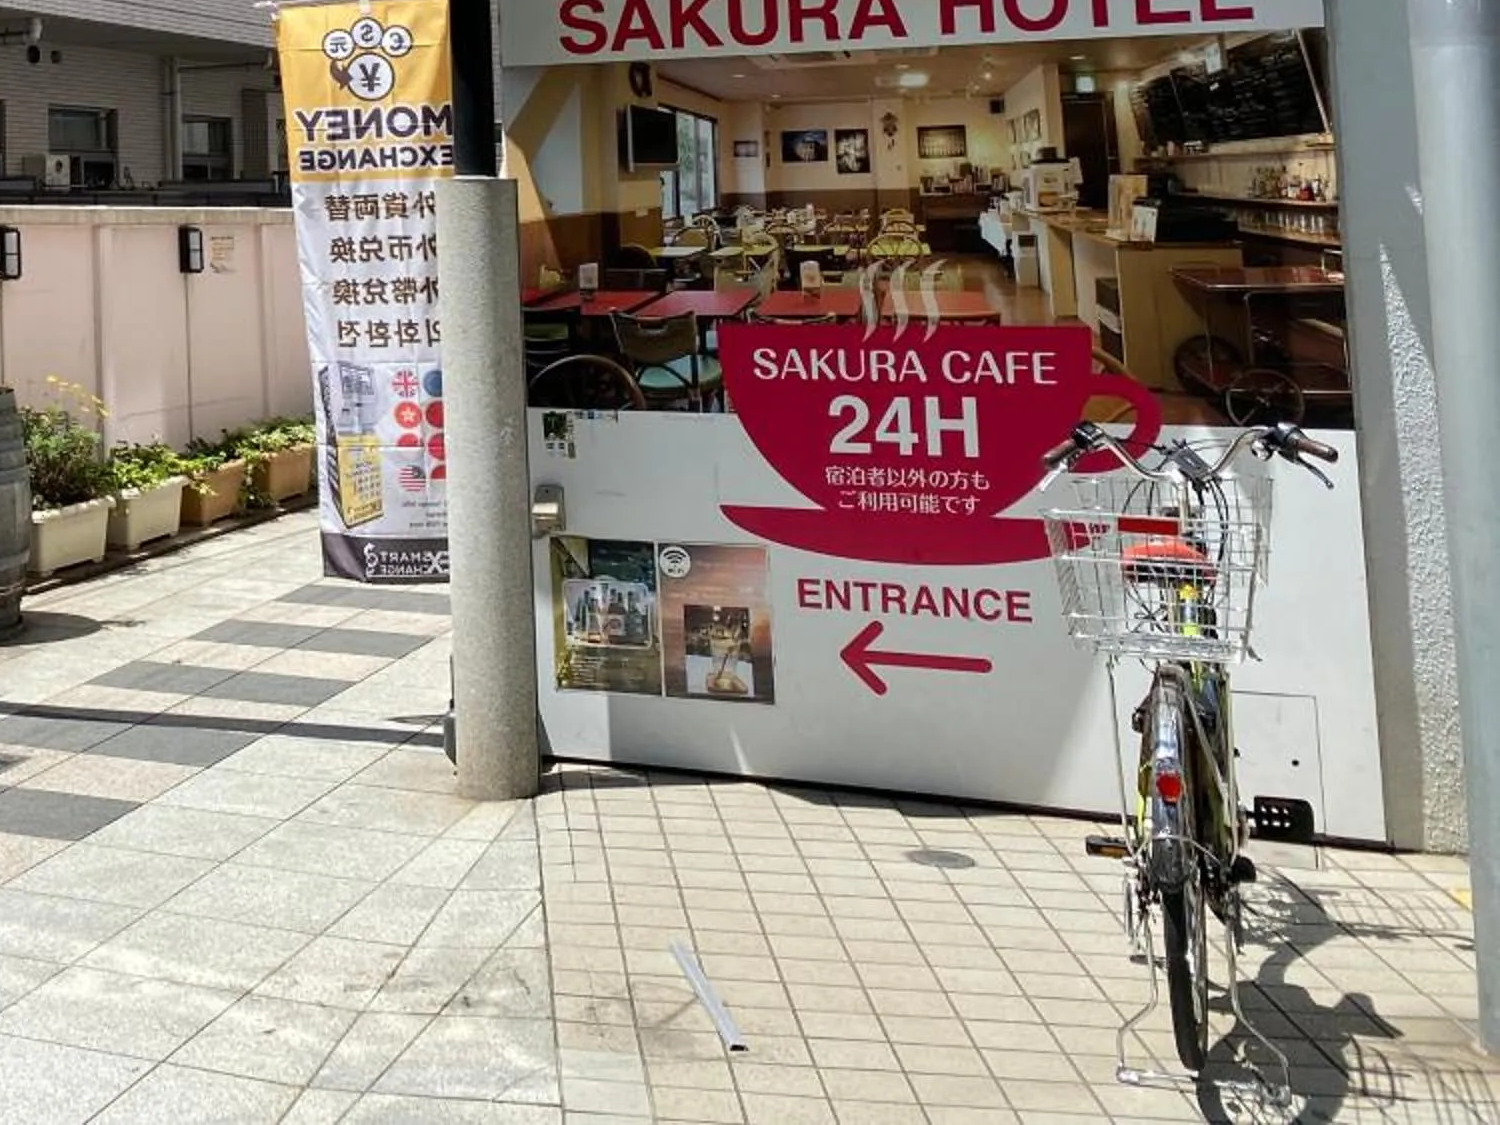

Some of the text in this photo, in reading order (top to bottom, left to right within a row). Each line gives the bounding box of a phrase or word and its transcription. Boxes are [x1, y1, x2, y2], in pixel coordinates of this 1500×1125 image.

[752, 346, 1058, 385] SAKURA CAFE
[828, 394, 980, 458] 24H
[825, 465, 990, 491] 宿泊者以外の方も
[838, 490, 981, 515] ご利用可能です
[797, 578, 1033, 623] ENTRANCE
